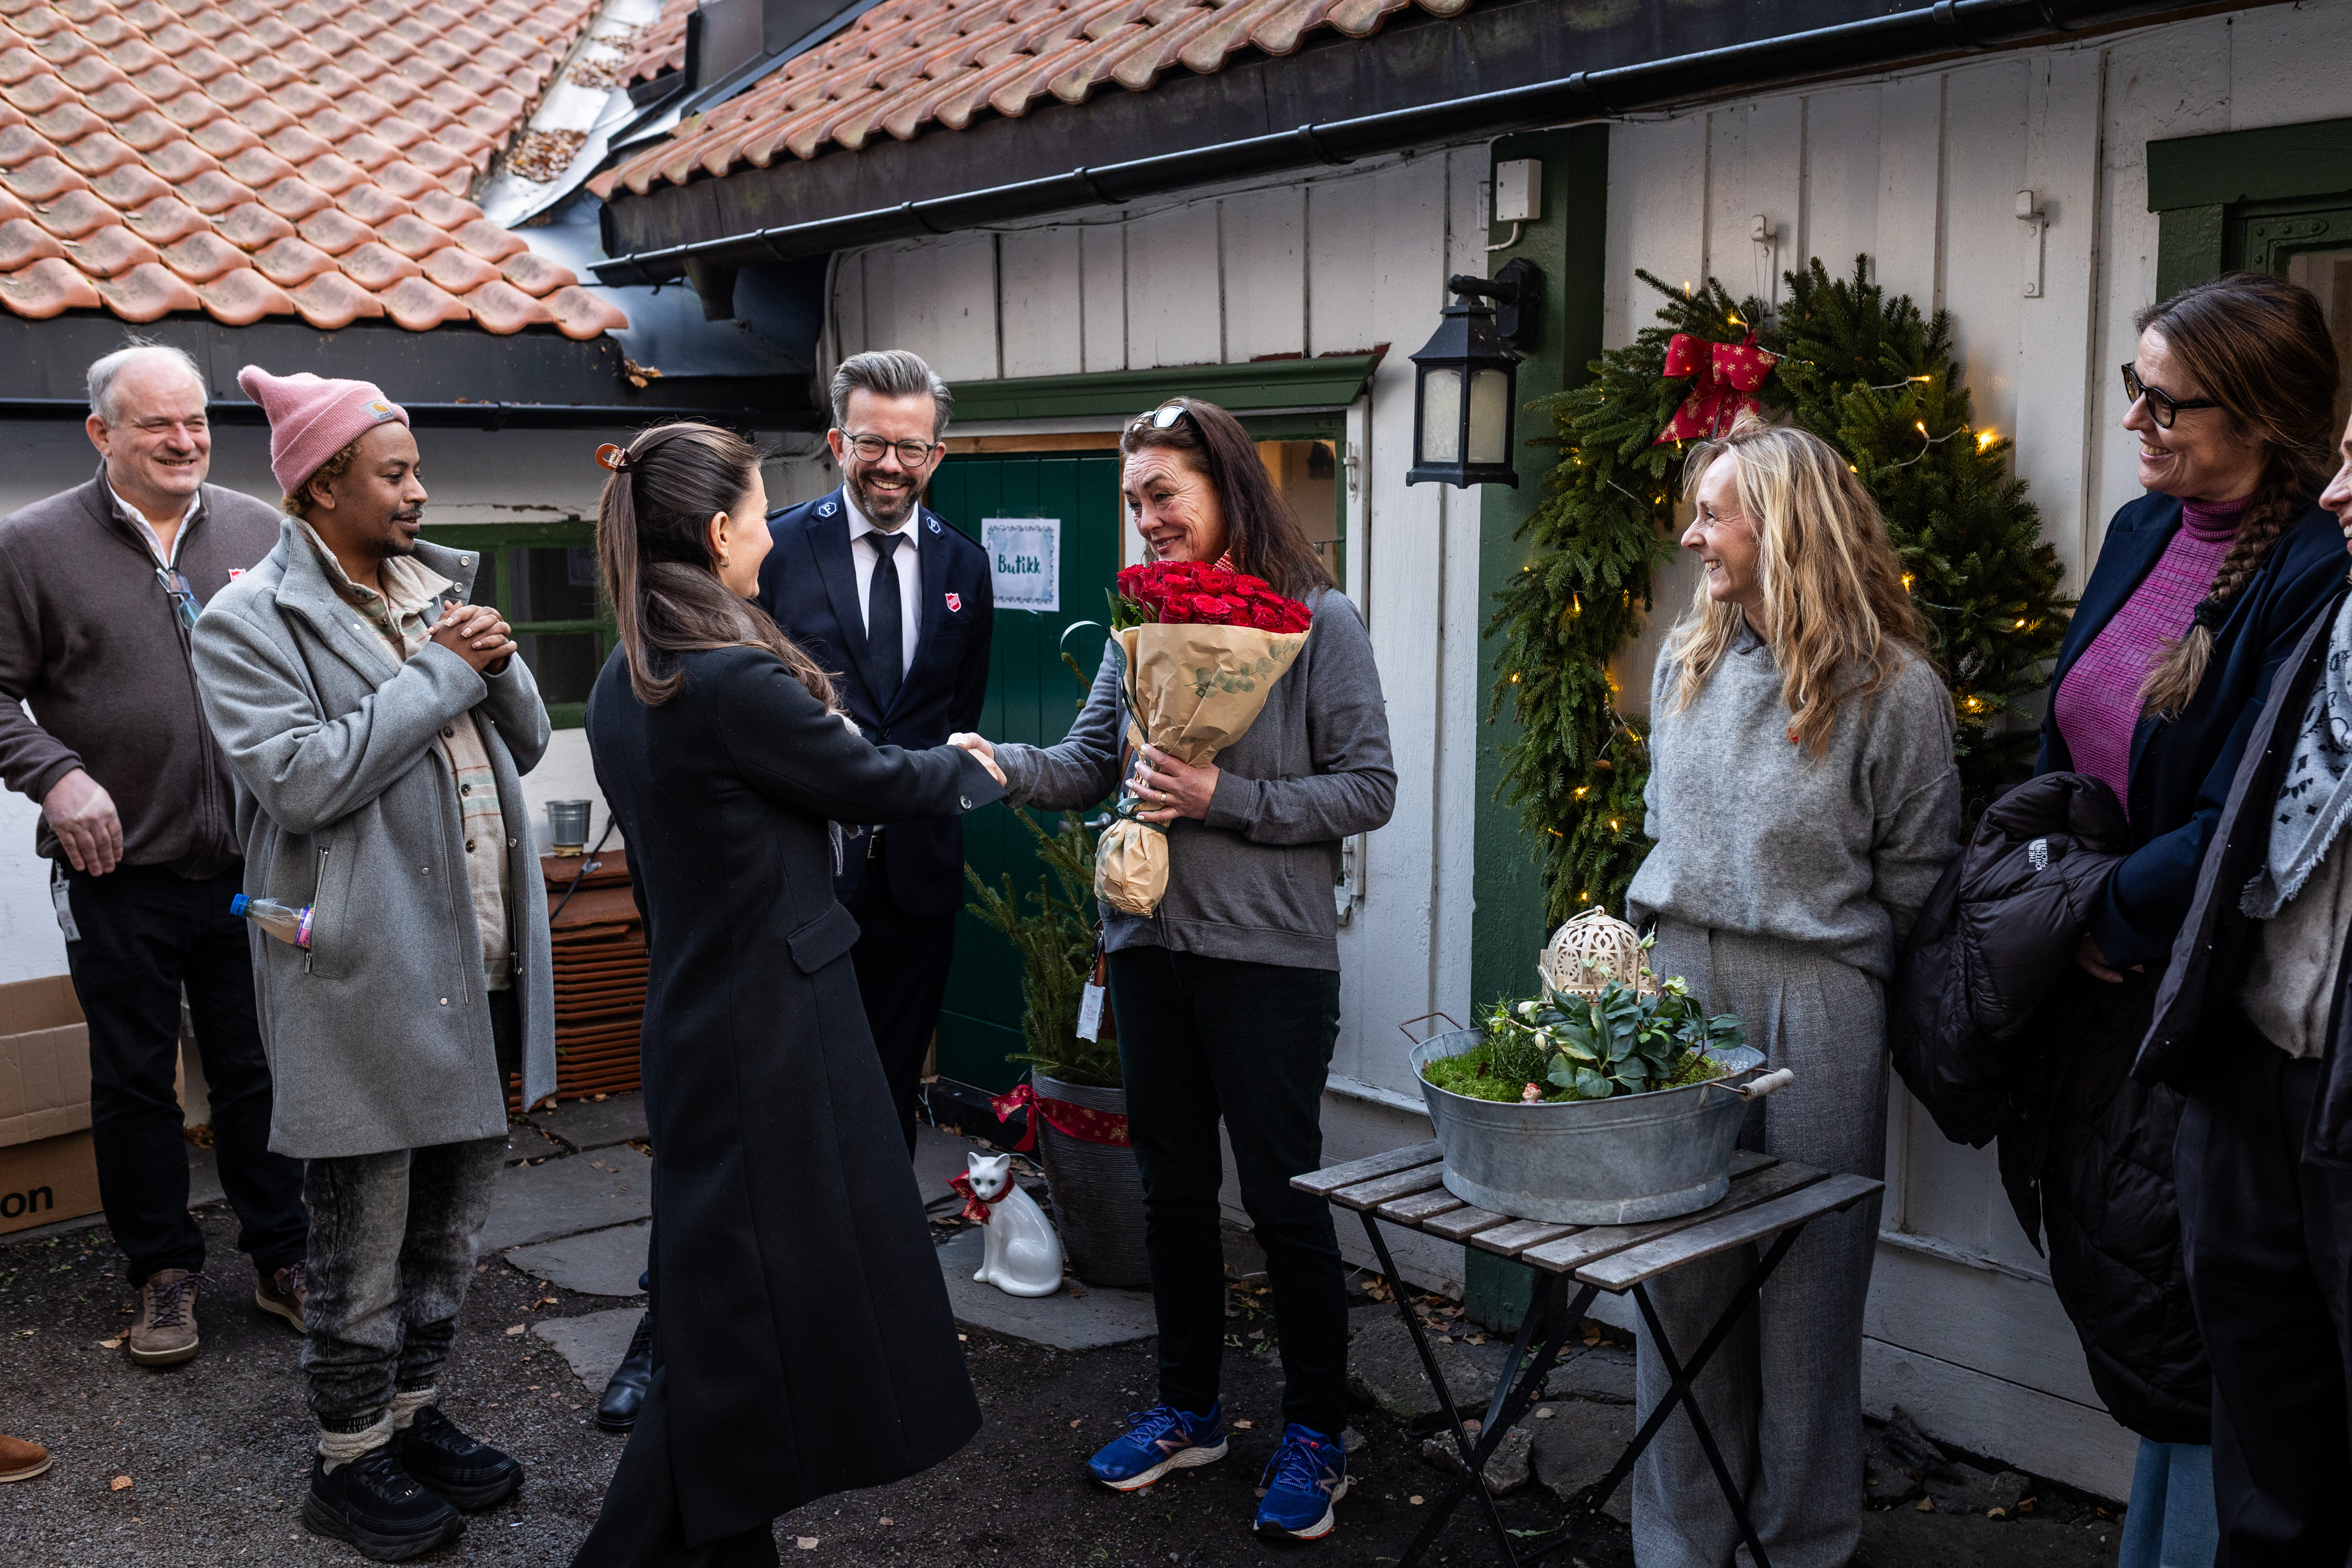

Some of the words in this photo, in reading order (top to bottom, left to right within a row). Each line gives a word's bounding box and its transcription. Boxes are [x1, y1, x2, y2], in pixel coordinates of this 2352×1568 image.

[822, 505, 831, 514] F
[930, 520, 936, 530] F
[998, 554, 1041, 574] Butikk
[1, 1185, 53, 1218] on
